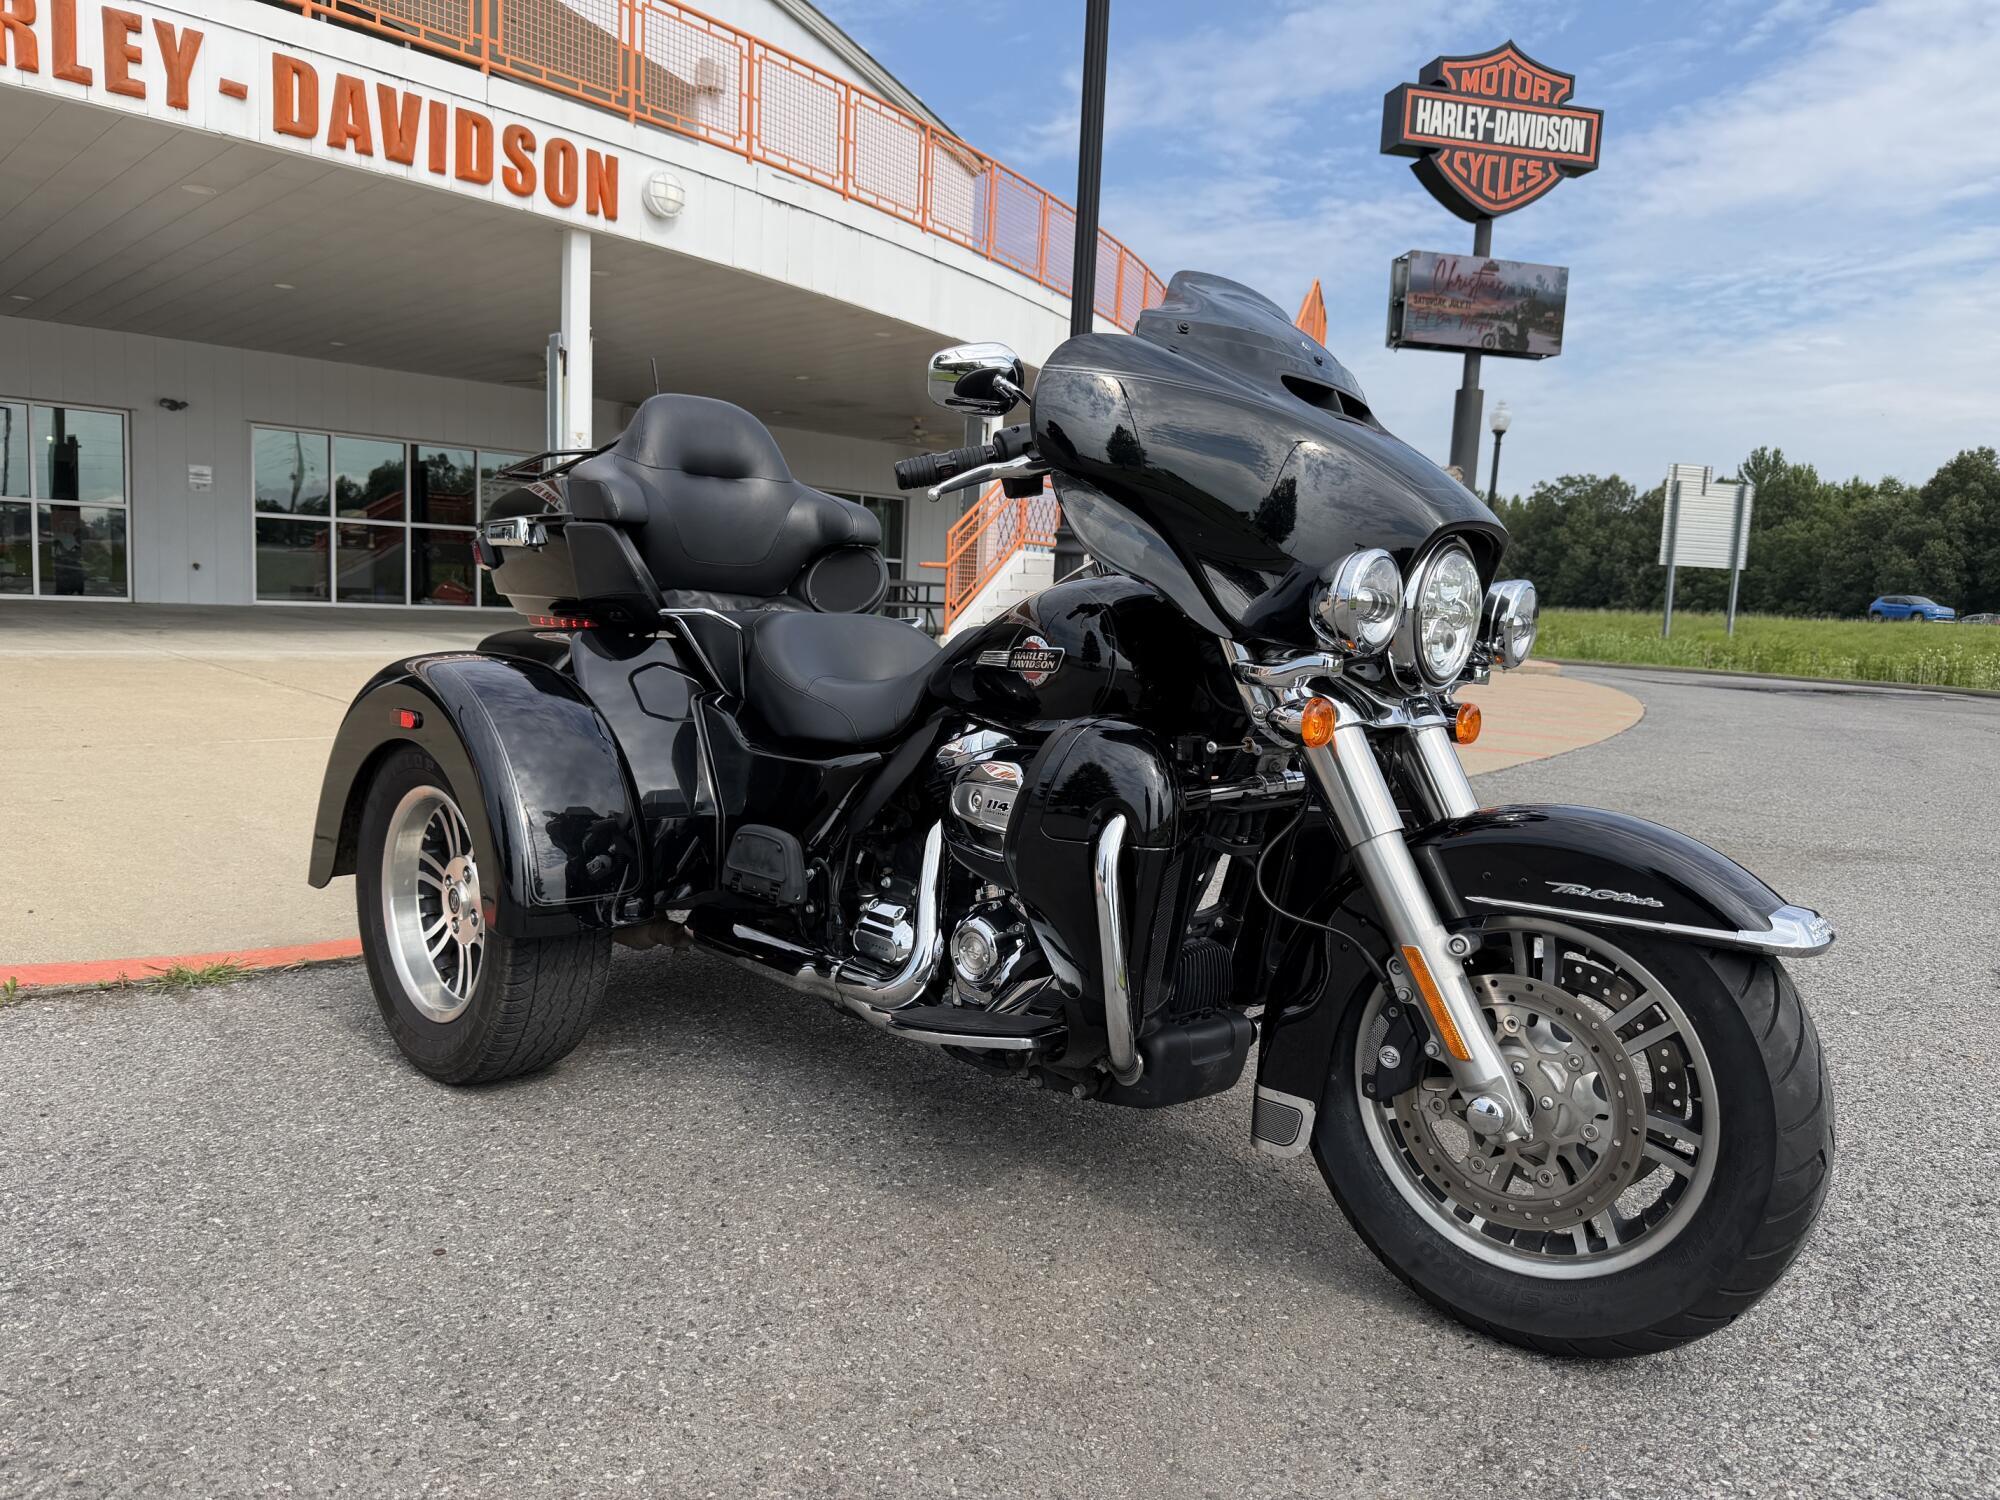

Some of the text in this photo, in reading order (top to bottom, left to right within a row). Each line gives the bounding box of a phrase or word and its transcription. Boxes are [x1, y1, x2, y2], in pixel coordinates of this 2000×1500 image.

[1461, 59, 1551, 104] MOTOR
[1415, 98, 1587, 154] HARLEY-DAVIDSON
[1453, 150, 1544, 201] CYCLES
[1433, 258, 1507, 301] Christmas
[1519, 286, 1538, 298] JULY
[1010, 659, 1056, 669] DAVIDSON
[1014, 651, 1055, 661] HARLEY-
[986, 799, 1010, 811] 114
